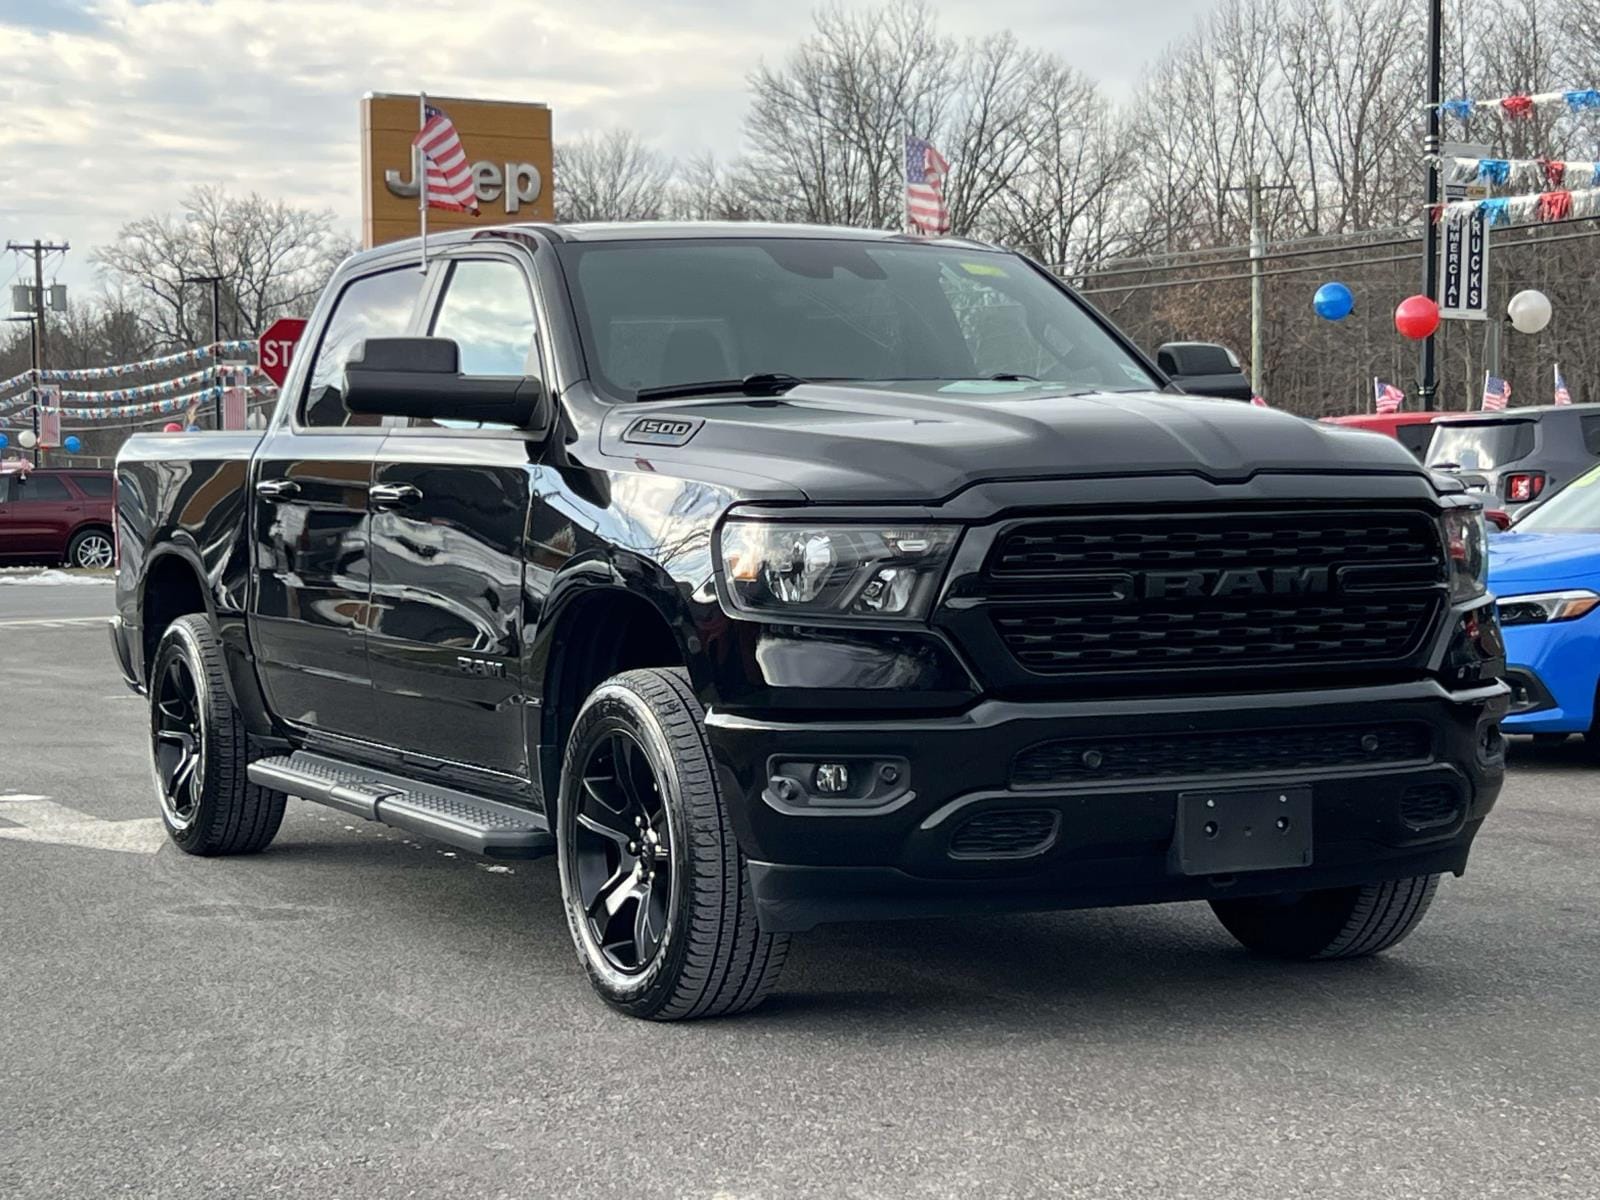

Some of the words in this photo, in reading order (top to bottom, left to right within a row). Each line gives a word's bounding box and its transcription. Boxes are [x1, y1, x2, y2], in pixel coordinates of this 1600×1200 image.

[385, 143, 541, 214] Jep
[1447, 217, 1461, 306] MMERCIAL
[263, 340, 299, 368] ST
[639, 420, 689, 435] 1500
[1144, 567, 1329, 599] RAM
[457, 656, 505, 678] RAM
